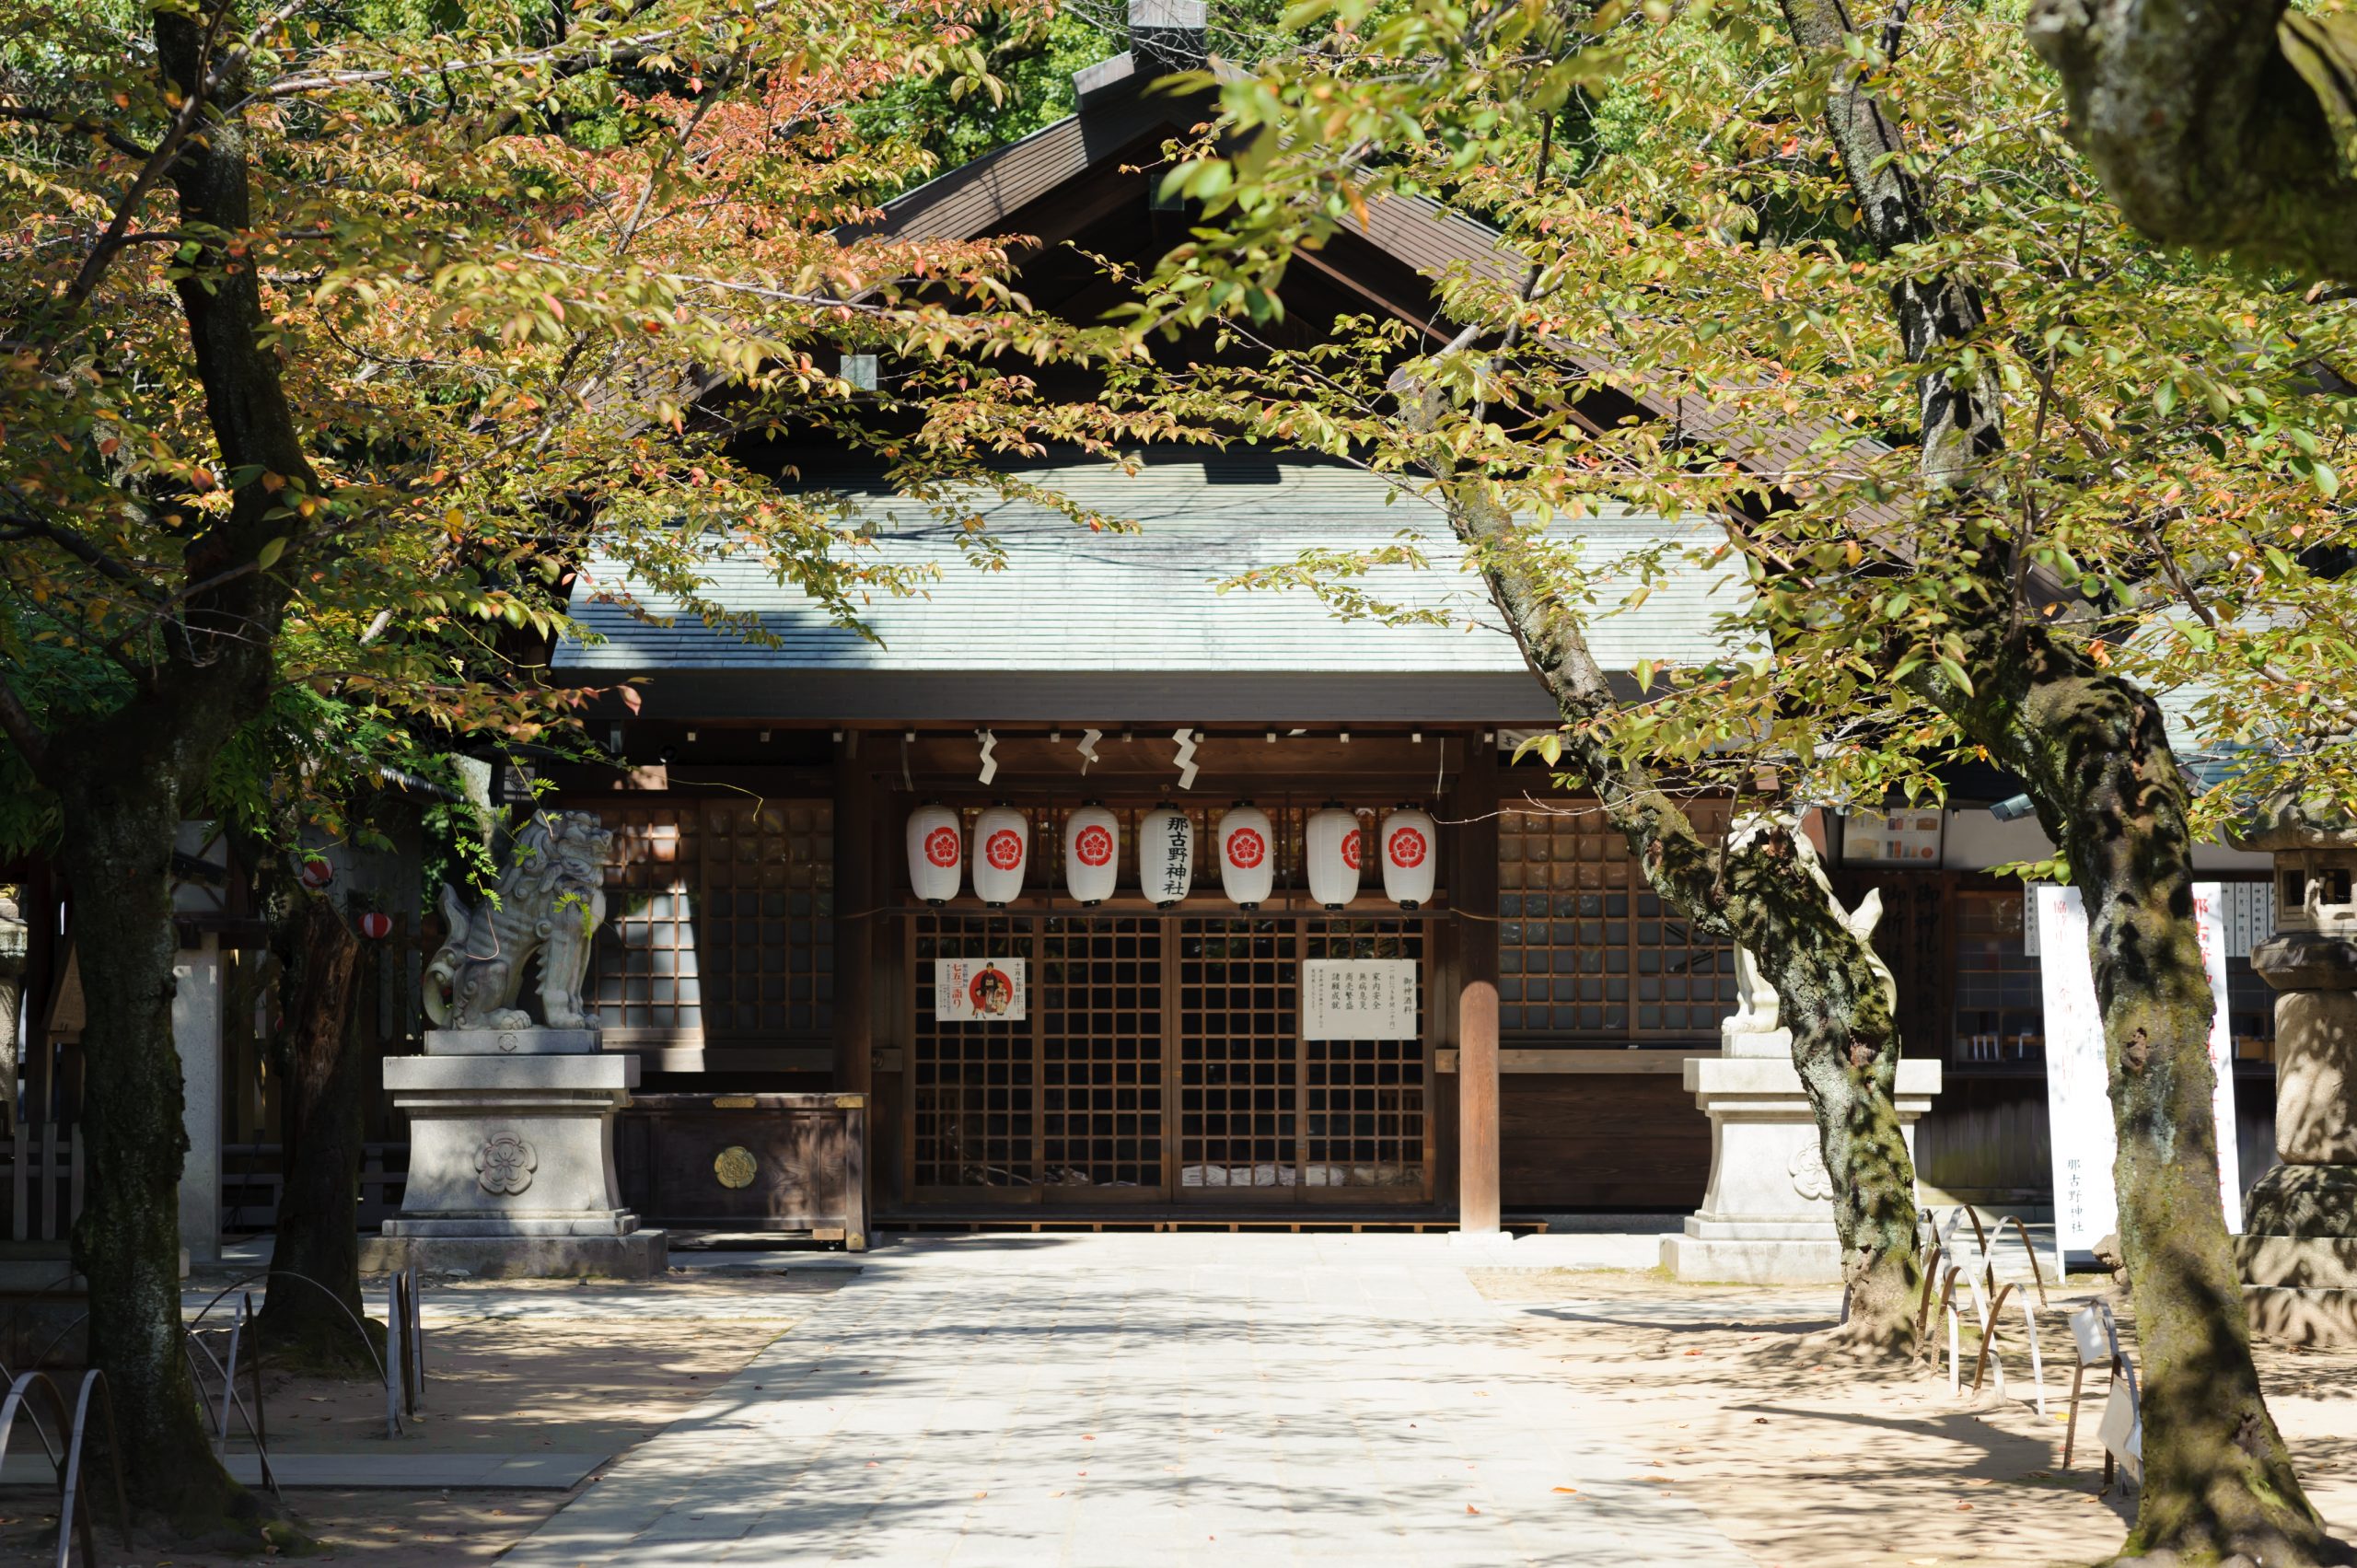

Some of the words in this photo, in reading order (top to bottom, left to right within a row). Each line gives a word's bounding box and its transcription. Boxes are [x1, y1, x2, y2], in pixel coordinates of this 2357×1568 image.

[1162, 817, 1189, 896] 那古野神社
[951, 963, 963, 1009] 七五三詣り
[1331, 972, 1341, 1010] 諸願成就
[1345, 972, 1354, 1010] 商売繁盛
[1359, 972, 1367, 1010] 無病息災
[1372, 972, 1381, 1010] 家内安全
[1403, 977, 1413, 1015] 御神酒料
[2068, 1158, 2084, 1234] 那古野神社
